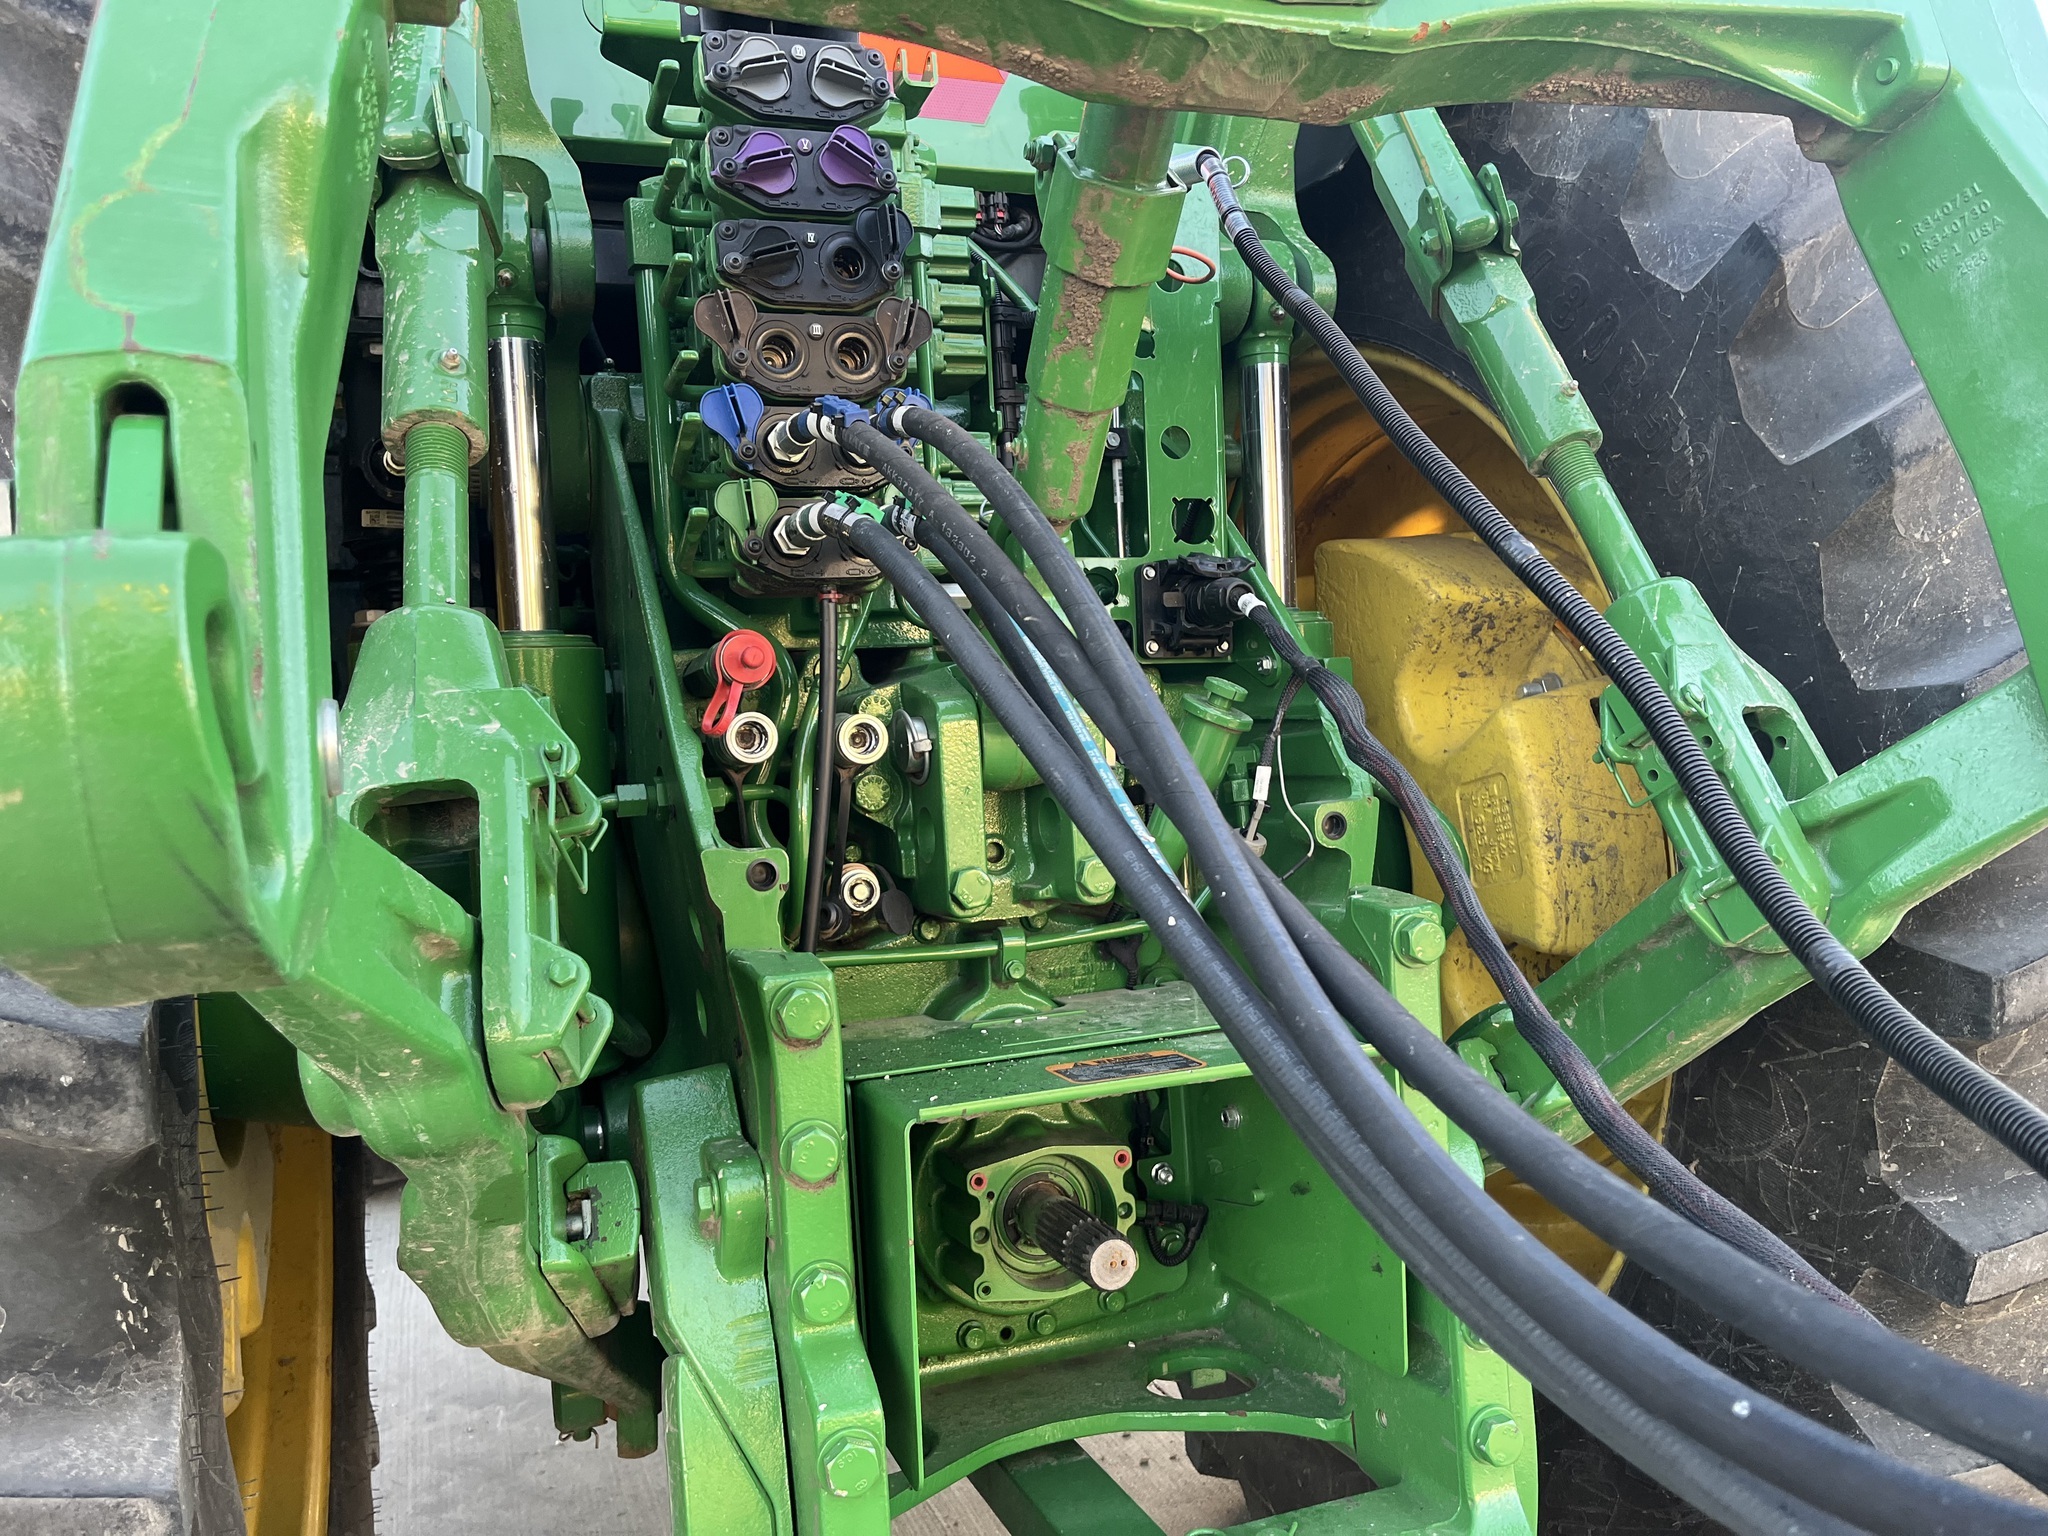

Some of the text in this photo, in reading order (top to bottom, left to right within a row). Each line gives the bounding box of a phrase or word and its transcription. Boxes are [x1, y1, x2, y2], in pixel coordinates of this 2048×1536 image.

[801, 138, 810, 150] V
[1911, 181, 1983, 238] R340731
[1919, 198, 1992, 255] R340730
[1968, 214, 2005, 245] USA
[1149, 882, 1172, 908] Mexico
[1175, 916, 1194, 936] Made
